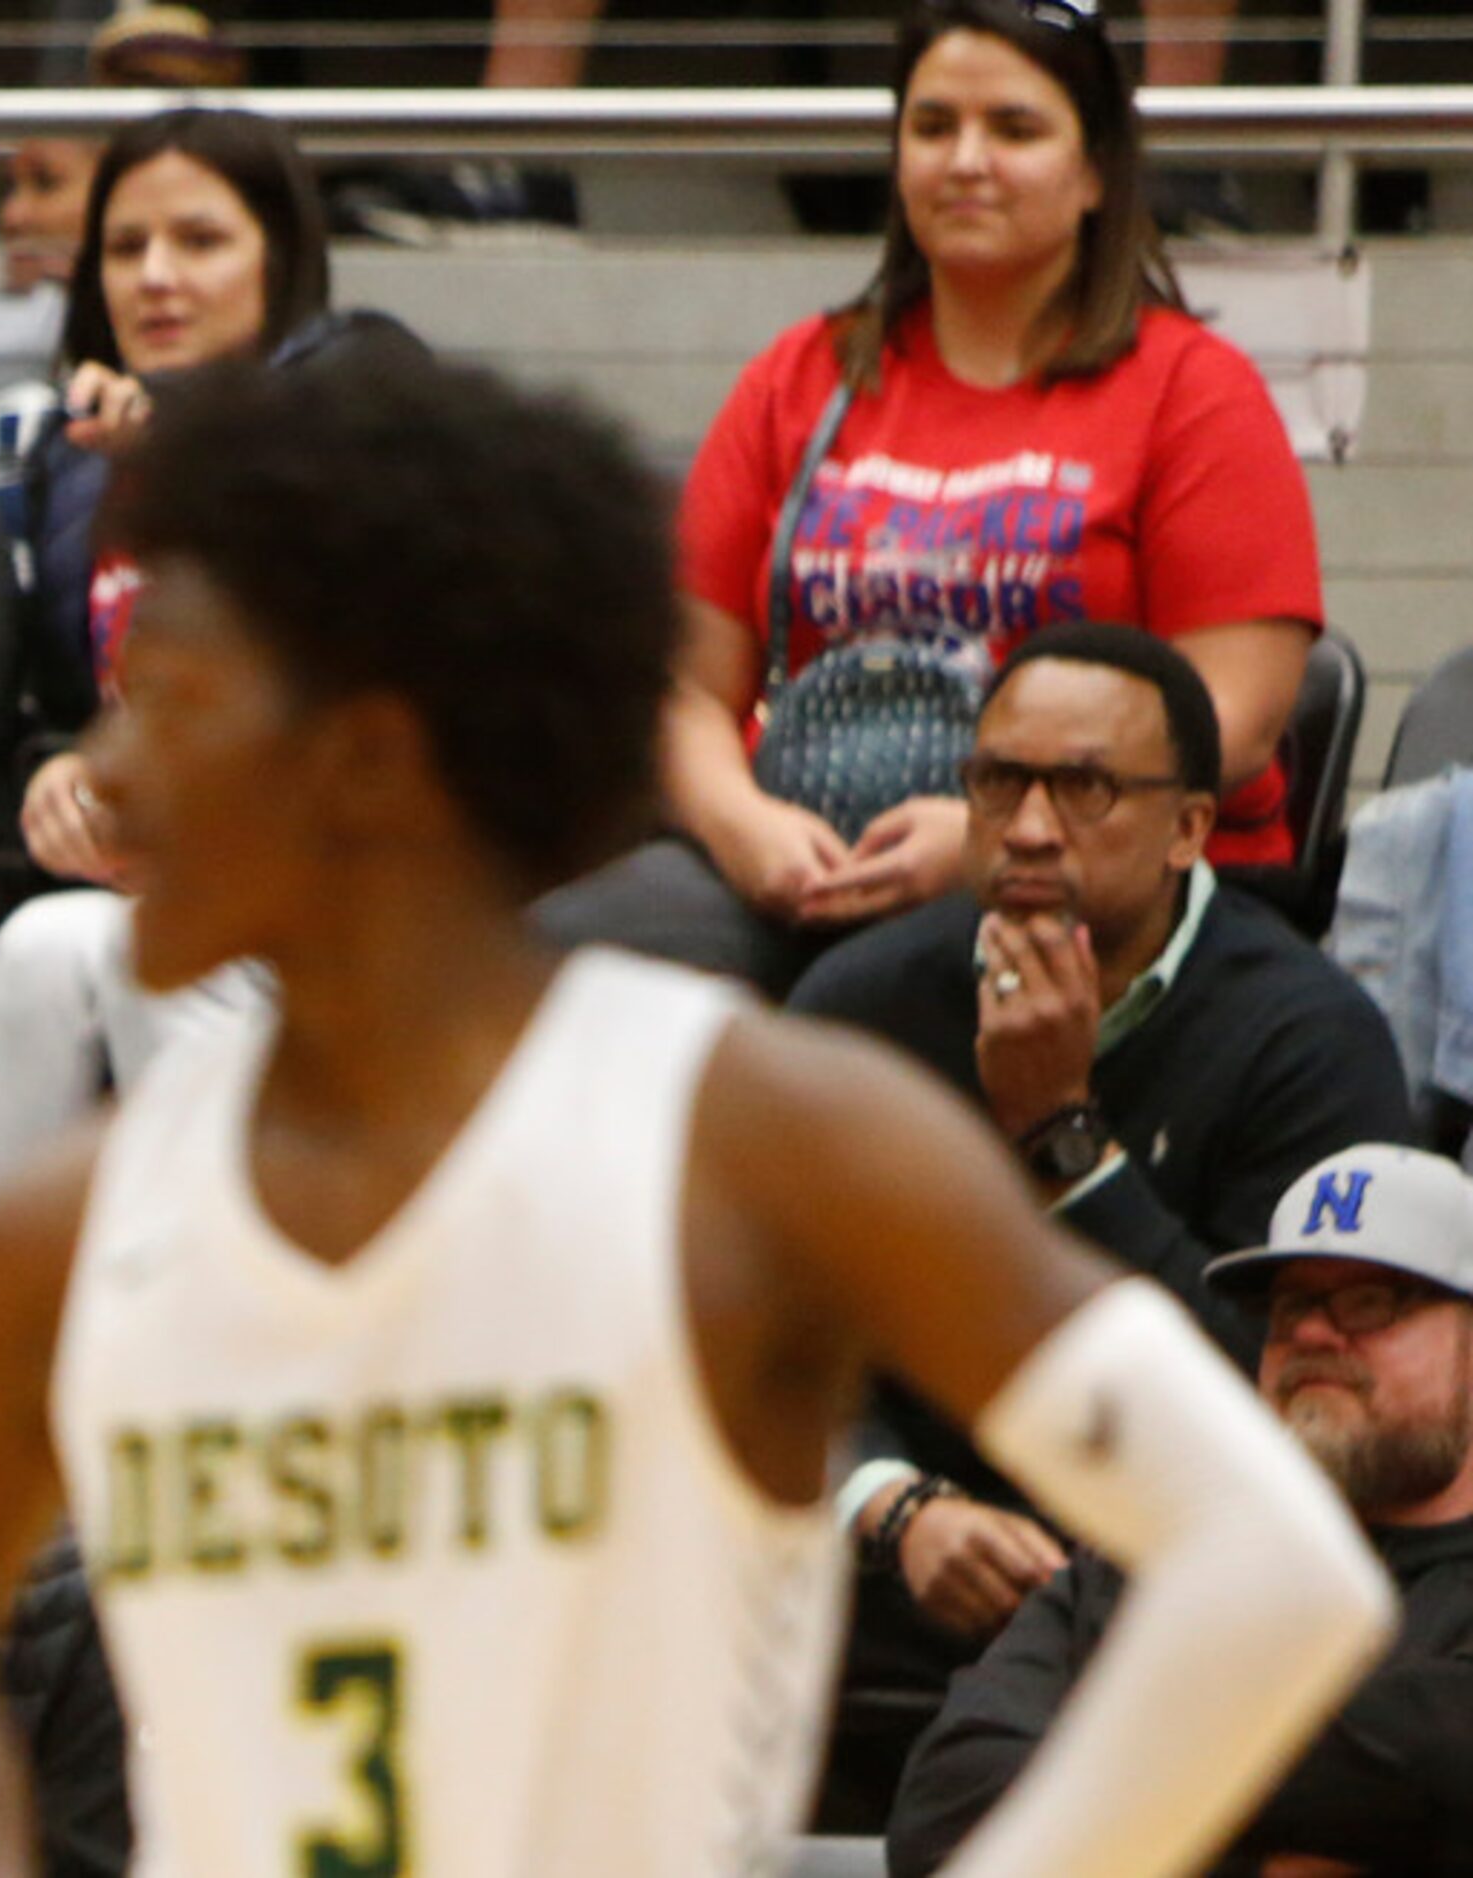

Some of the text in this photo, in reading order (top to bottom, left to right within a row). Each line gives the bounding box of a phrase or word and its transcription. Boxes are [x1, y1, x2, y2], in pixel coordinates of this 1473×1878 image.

[1300, 1170, 1373, 1236] N
[98, 1388, 611, 1577] DESOTO
[296, 1638, 408, 1878] 3
